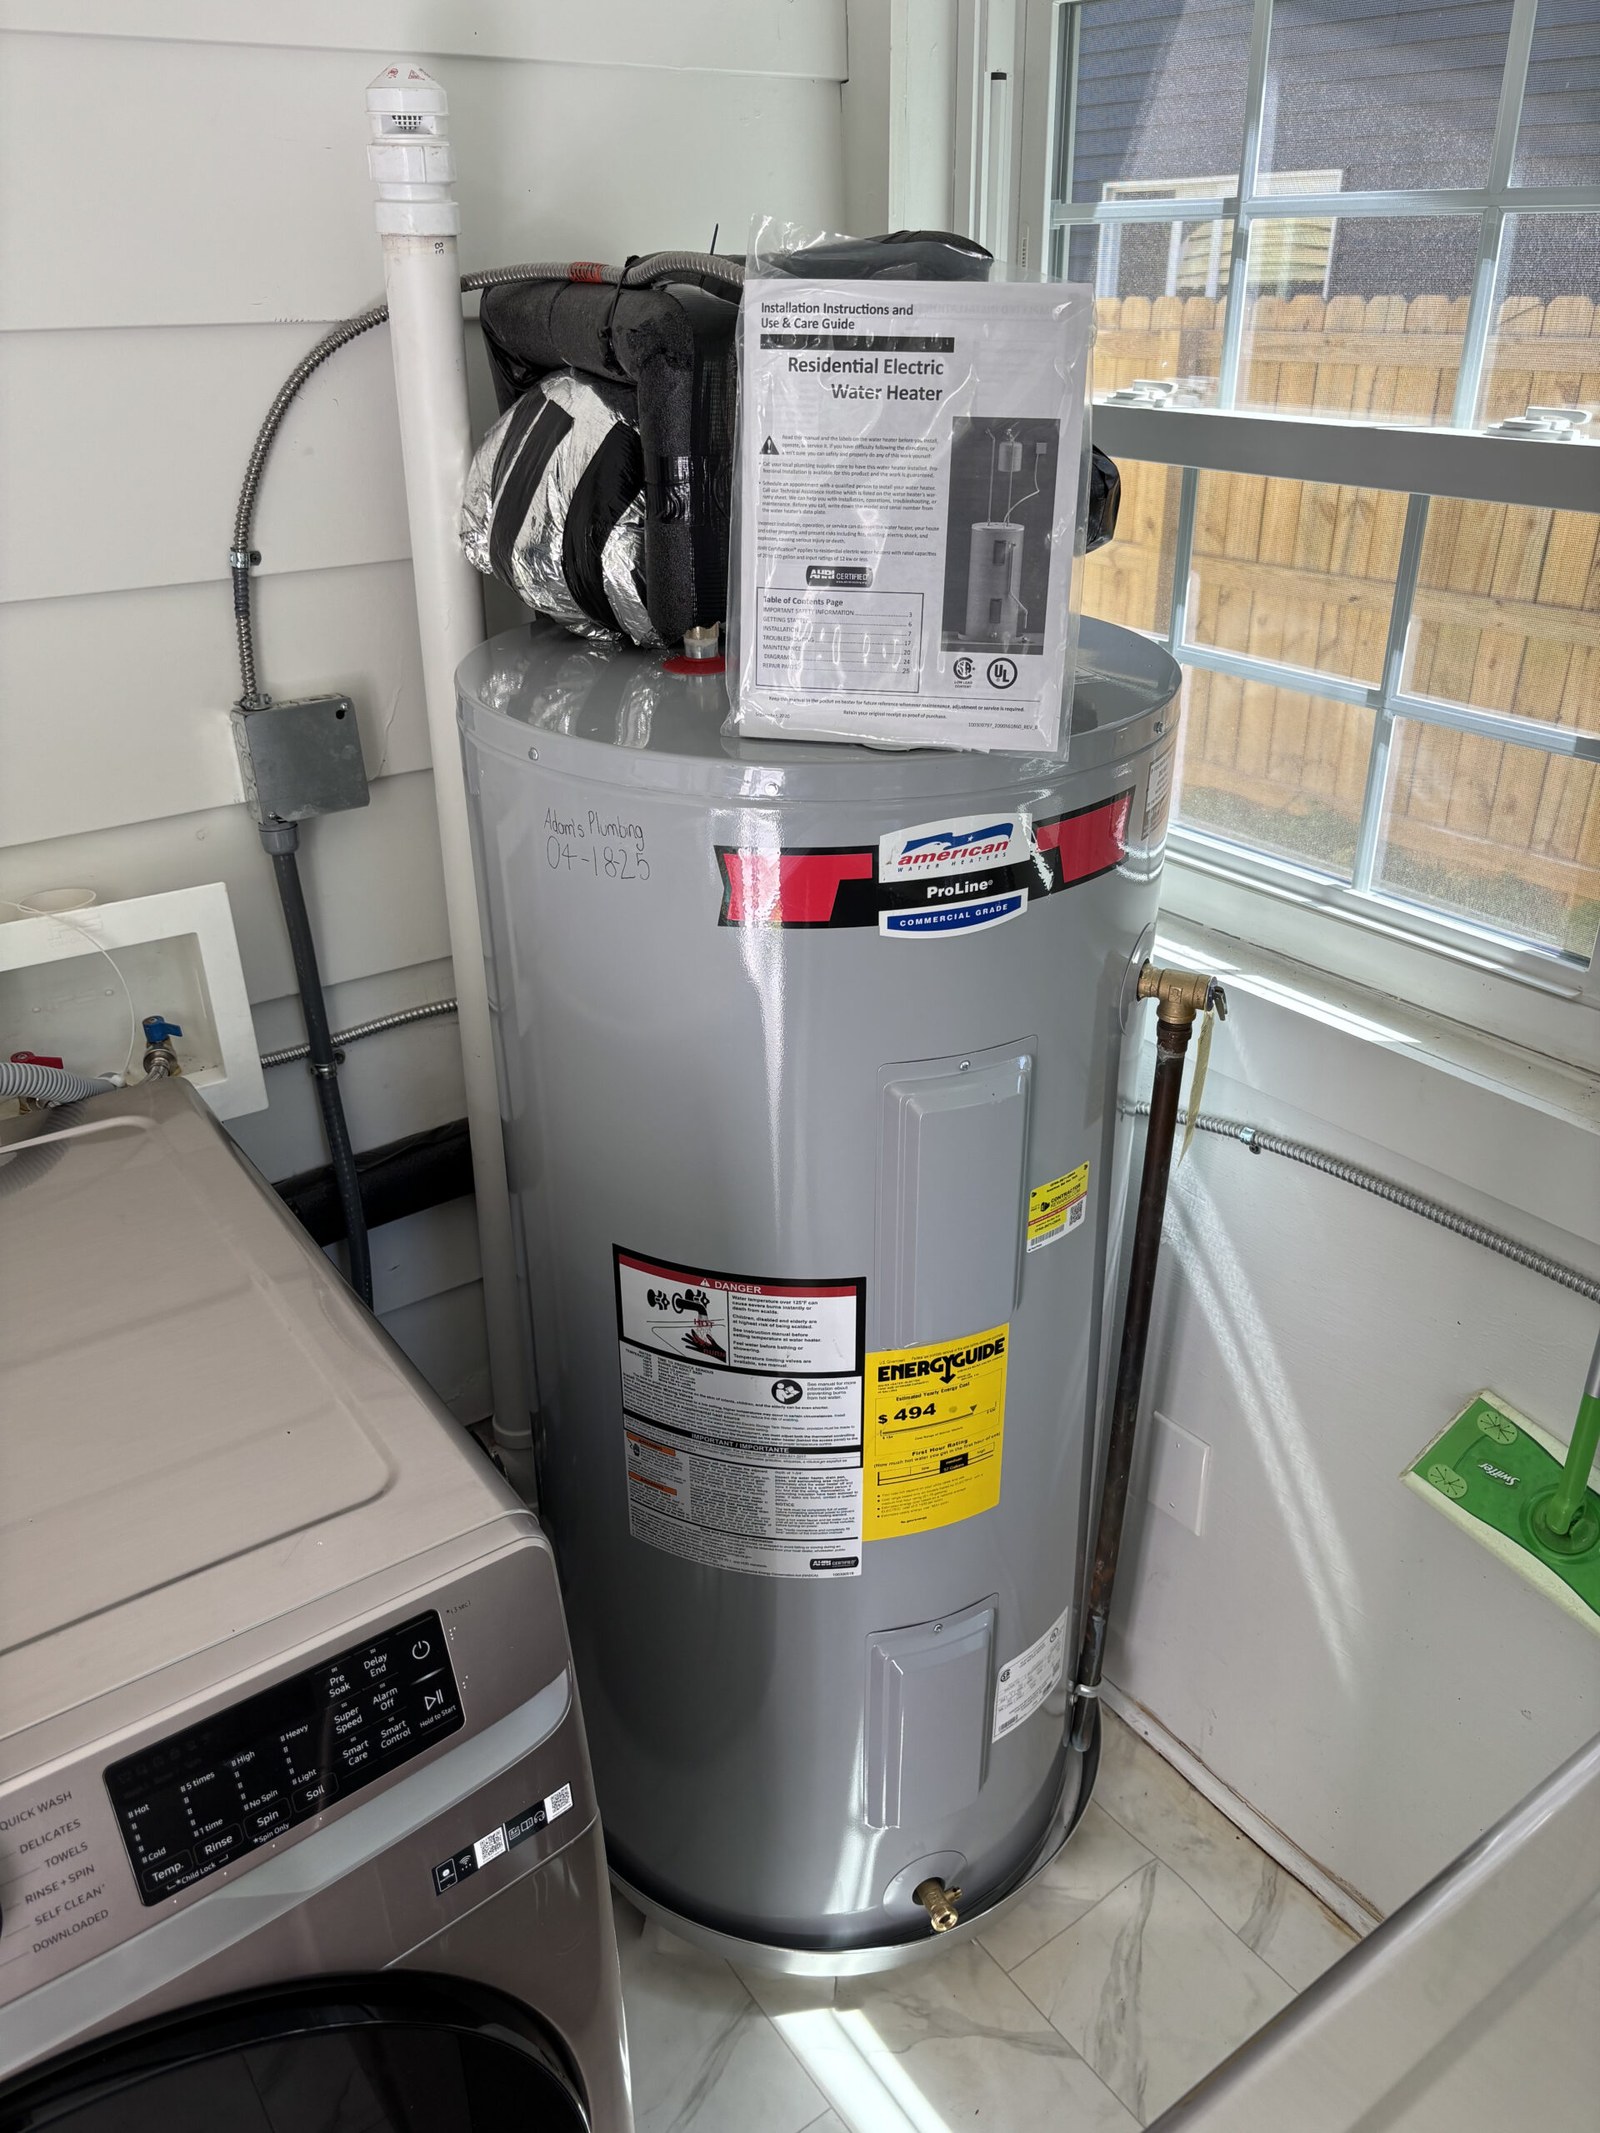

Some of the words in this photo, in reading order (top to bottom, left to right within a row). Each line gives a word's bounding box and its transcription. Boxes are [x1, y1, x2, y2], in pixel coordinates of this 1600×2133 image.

[761, 302, 819, 313] Installation
[823, 303, 890, 315] Instructions
[892, 304, 913, 315] and
[761, 317, 779, 328] Use
[782, 318, 792, 328] &
[794, 318, 819, 329] Care
[822, 318, 855, 330] Guide
[789, 357, 879, 374] Residential
[884, 359, 944, 375] Electric
[831, 383, 882, 400] Water
[887, 385, 942, 401] Heater
[763, 606, 794, 614] IMPORTANT
[764, 596, 782, 604] Table
[792, 597, 824, 606] Contents
[826, 599, 844, 607] Page
[764, 653, 793, 661] DIAGRAM
[994, 664, 1010, 683] UL
[544, 807, 585, 838] Adam's
[897, 863, 940, 873] WATER
[951, 852, 1007, 866] HEATERS
[898, 840, 1010, 867] american
[899, 908, 971, 927] COMMERCIAL
[975, 903, 1008, 917] GRADE
[714, 1281, 762, 1295] DANGER
[878, 1337, 1005, 1383] ENERGYGUIDE
[896, 1392, 922, 1402] Estimated
[923, 1389, 940, 1397] Yearly
[940, 1385, 958, 1394] Energy
[958, 1381, 970, 1389] Cost
[878, 1414, 888, 1424] $
[893, 1402, 937, 1421] 494
[691, 1433, 734, 1447] IMPORTANT
[740, 1442, 789, 1454] IMPORTANTE
[912, 1449, 928, 1457] First
[929, 1446, 946, 1454] Hour
[947, 1439, 968, 1449] Rating
[1477, 1463, 1521, 1486] Swiffer
[363, 1653, 387, 1670] Delay
[370, 1663, 387, 1678] End
[329, 1673, 345, 1687] Pre
[329, 1681, 351, 1698] Soak
[372, 1687, 398, 1705] Alarm
[380, 1697, 394, 1711] Off
[334, 1706, 359, 1724] Super
[419, 1717, 434, 1729] Hold
[434, 1712, 441, 1721] to
[441, 1704, 457, 1717] Start
[286, 1724, 309, 1741] Heavy
[336, 1714, 363, 1735] Speed
[380, 1720, 406, 1739] Smart
[381, 1727, 411, 1750] Control
[236, 1751, 255, 1764] High
[342, 1740, 369, 1759] Smart
[348, 1751, 368, 1766] Care
[186, 1782, 192, 1790] 5
[193, 1771, 215, 1787] times
[298, 1768, 317, 1783] Light
[249, 1799, 261, 1808] No
[261, 1789, 278, 1802] Spin
[306, 1784, 325, 1801] Soil
[0, 1807, 36, 1831] QUICK
[37, 1790, 72, 1813] WASH
[134, 1803, 150, 1816] Hot
[256, 1810, 279, 1827] Spin
[205, 1818, 223, 1832] time
[274, 1822, 289, 1835] Only
[19, 1818, 81, 1854] DELICATES
[204, 1835, 233, 1855] Rinse
[44, 1841, 88, 1868] TOWELS
[148, 1846, 166, 1861] Cold
[152, 1862, 185, 1882] Temp.
[200, 1862, 216, 1875] Lock
[25, 1880, 58, 1904] RINSE
[60, 1879, 67, 1887] +
[68, 1863, 95, 1883] SPIN
[34, 1904, 62, 1925] SELF
[32, 1909, 109, 1953] DOWNLOADED
